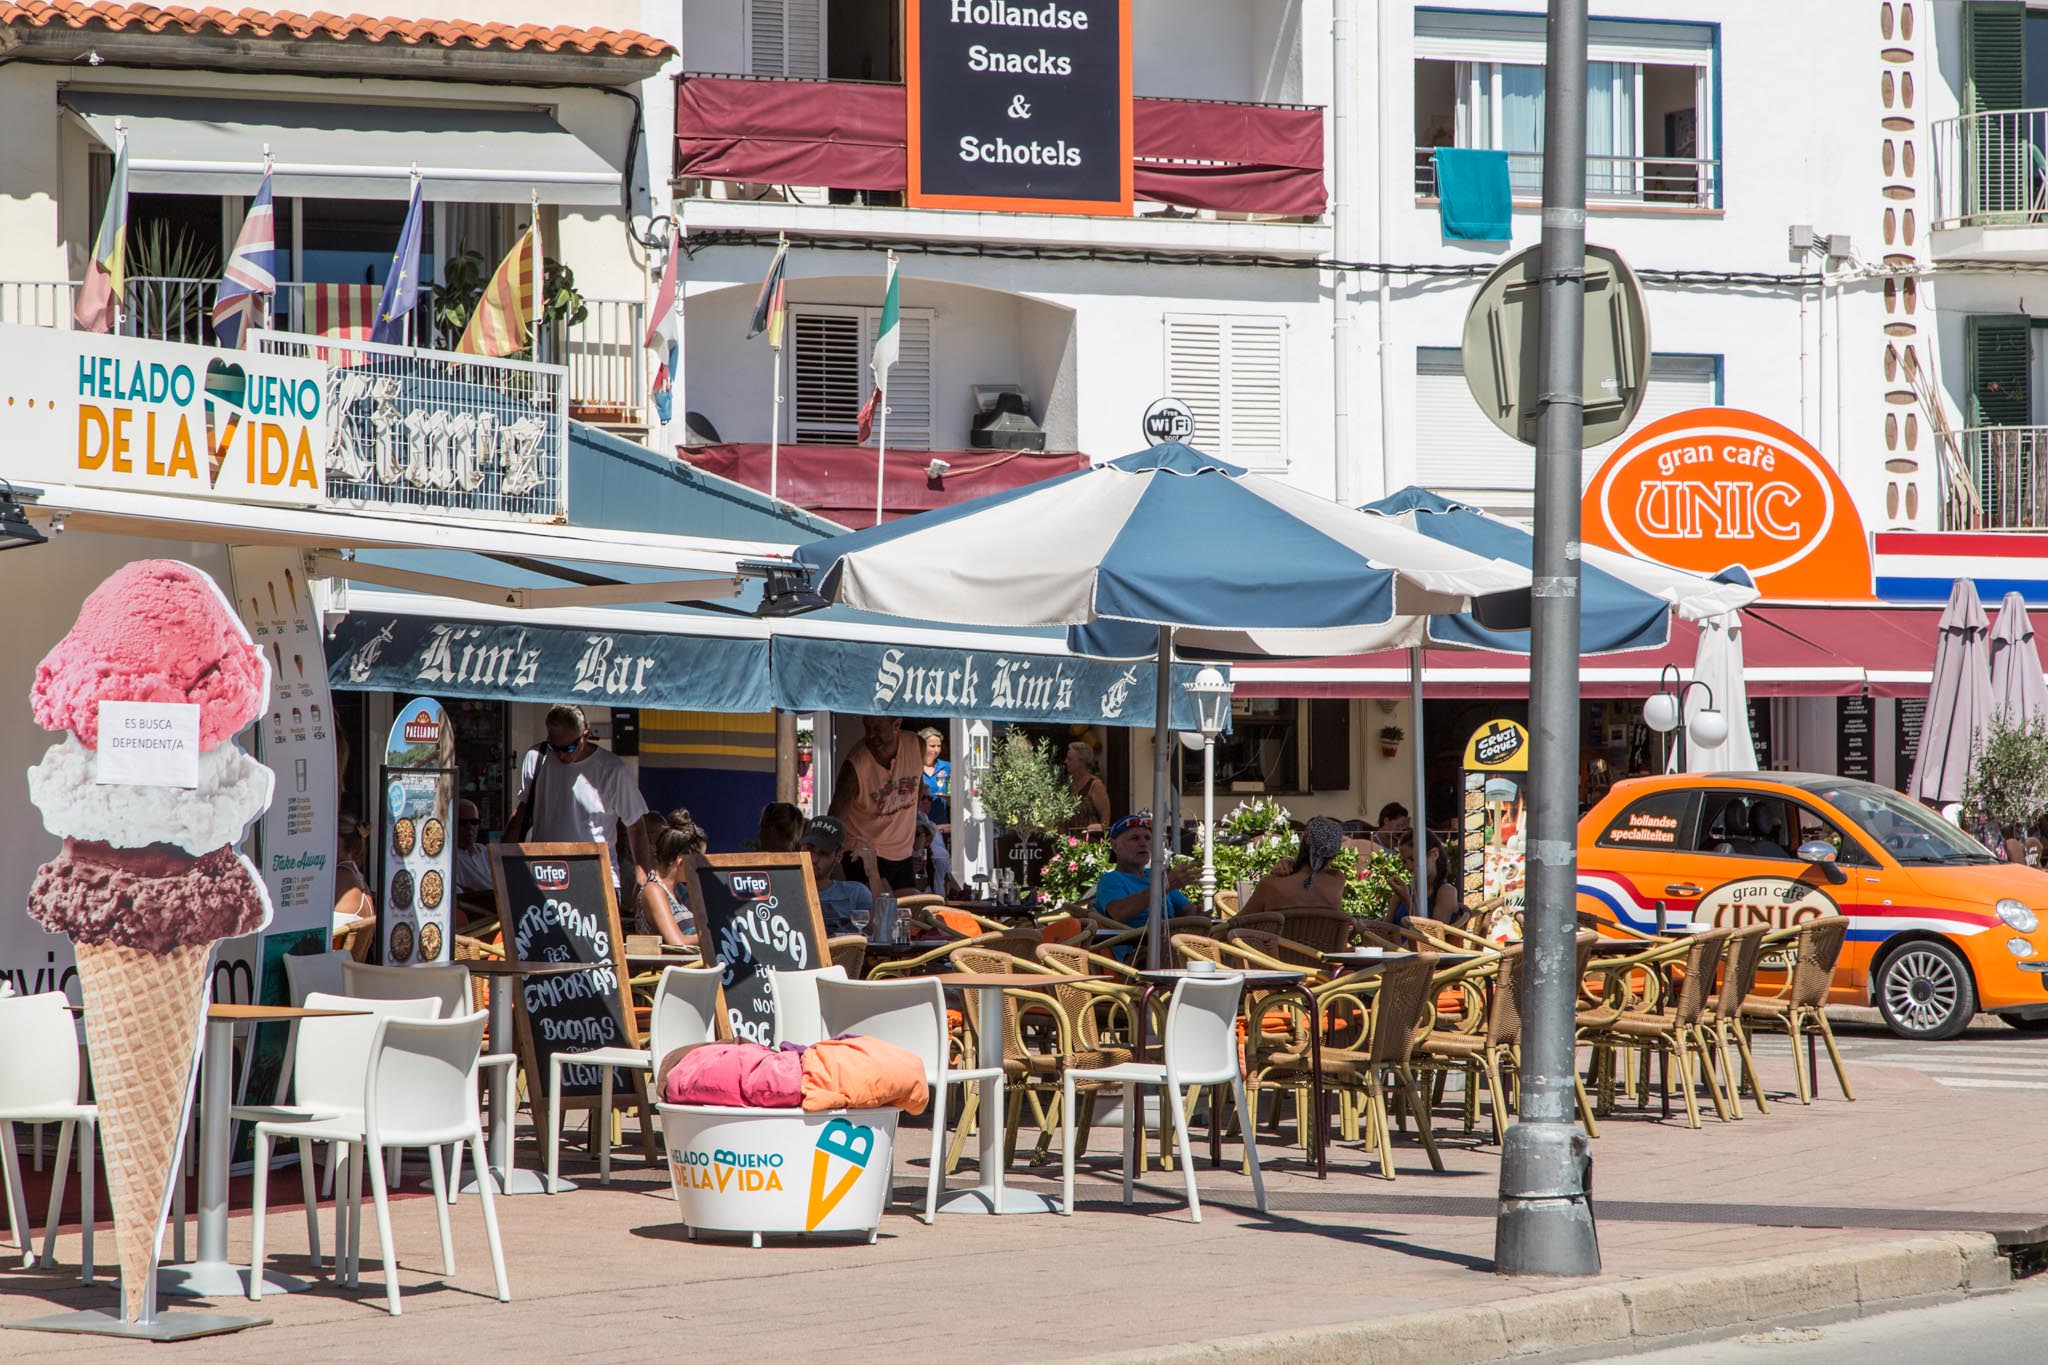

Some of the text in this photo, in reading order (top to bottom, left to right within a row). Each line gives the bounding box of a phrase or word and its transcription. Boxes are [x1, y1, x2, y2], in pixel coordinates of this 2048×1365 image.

[950, 0, 1089, 30] Hollandse
[968, 44, 1072, 76] Snacks
[1007, 93, 1032, 119] &
[959, 135, 1082, 167] Schotels
[79, 354, 195, 407] HELADO
[78, 403, 133, 474] DE
[146, 411, 199, 479] LA
[1658, 444, 1714, 476] gran
[1635, 480, 1802, 541] UNIC
[416, 622, 656, 696] Kim's Bar
[873, 648, 1075, 712] Snack Kim's
[124, 718, 173, 730] ES BUSCA
[405, 725, 439, 739] PAELLADOR
[112, 737, 184, 751] DEPENDENT/A
[811, 820, 838, 835] ARMY
[1629, 813, 1677, 829] hollandse
[1610, 828, 1675, 843] specialiteiten
[272, 851, 326, 872] Take Away
[534, 865, 565, 883] Orfeo
[733, 876, 766, 893] Orfeo
[1733, 886, 1767, 902] gran
[691, 1166, 714, 1190] LA
[714, 1162, 784, 1194] VIDA
